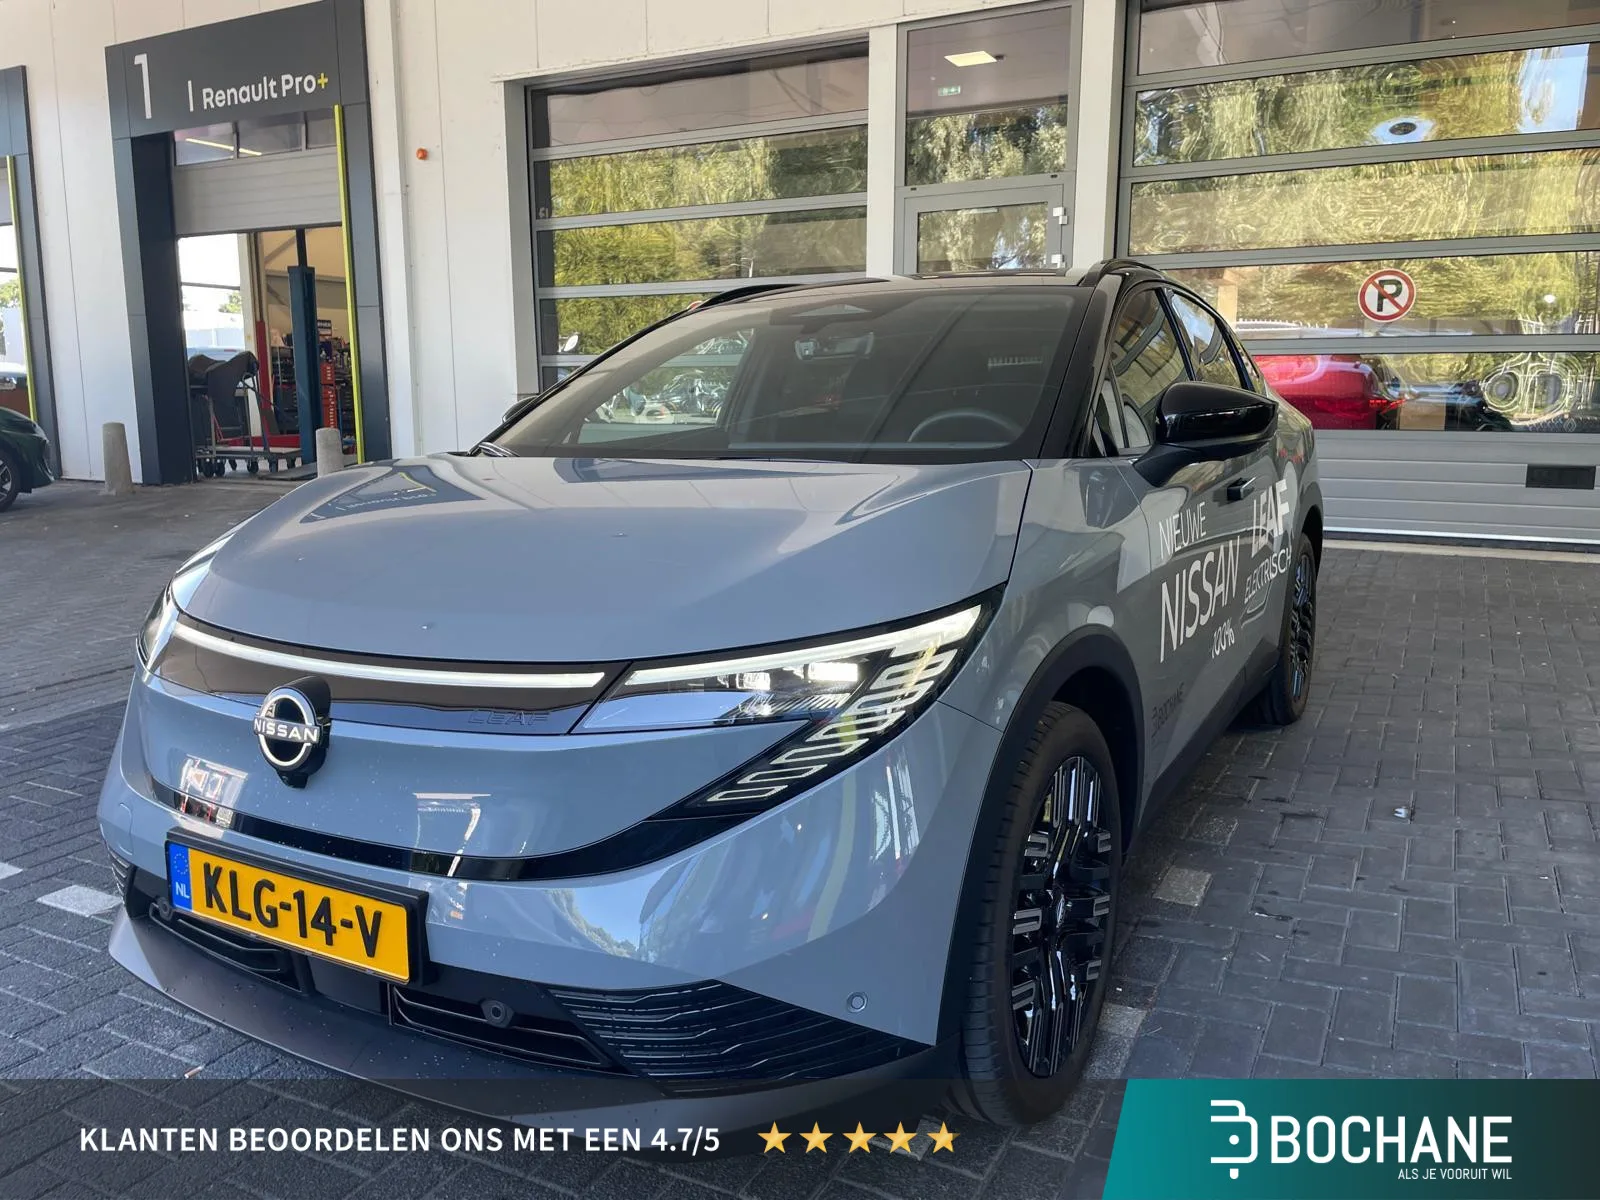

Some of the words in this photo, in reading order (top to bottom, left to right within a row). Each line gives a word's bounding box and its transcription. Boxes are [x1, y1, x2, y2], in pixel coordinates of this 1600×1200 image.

[134, 53, 152, 119] 1
[202, 76, 278, 109] Renault
[281, 73, 329, 97] Pro+
[1377, 279, 1403, 312] P
[1158, 501, 1207, 560] NIEUWE
[1160, 535, 1240, 663] NISSAN
[1251, 478, 1290, 558] LEAF
[1211, 617, 1235, 659] 100%
[1244, 547, 1292, 604] ELEKTRISCH
[254, 718, 318, 742] NISSAN
[175, 882, 190, 898] NL
[203, 862, 382, 958] KLG-14-V
